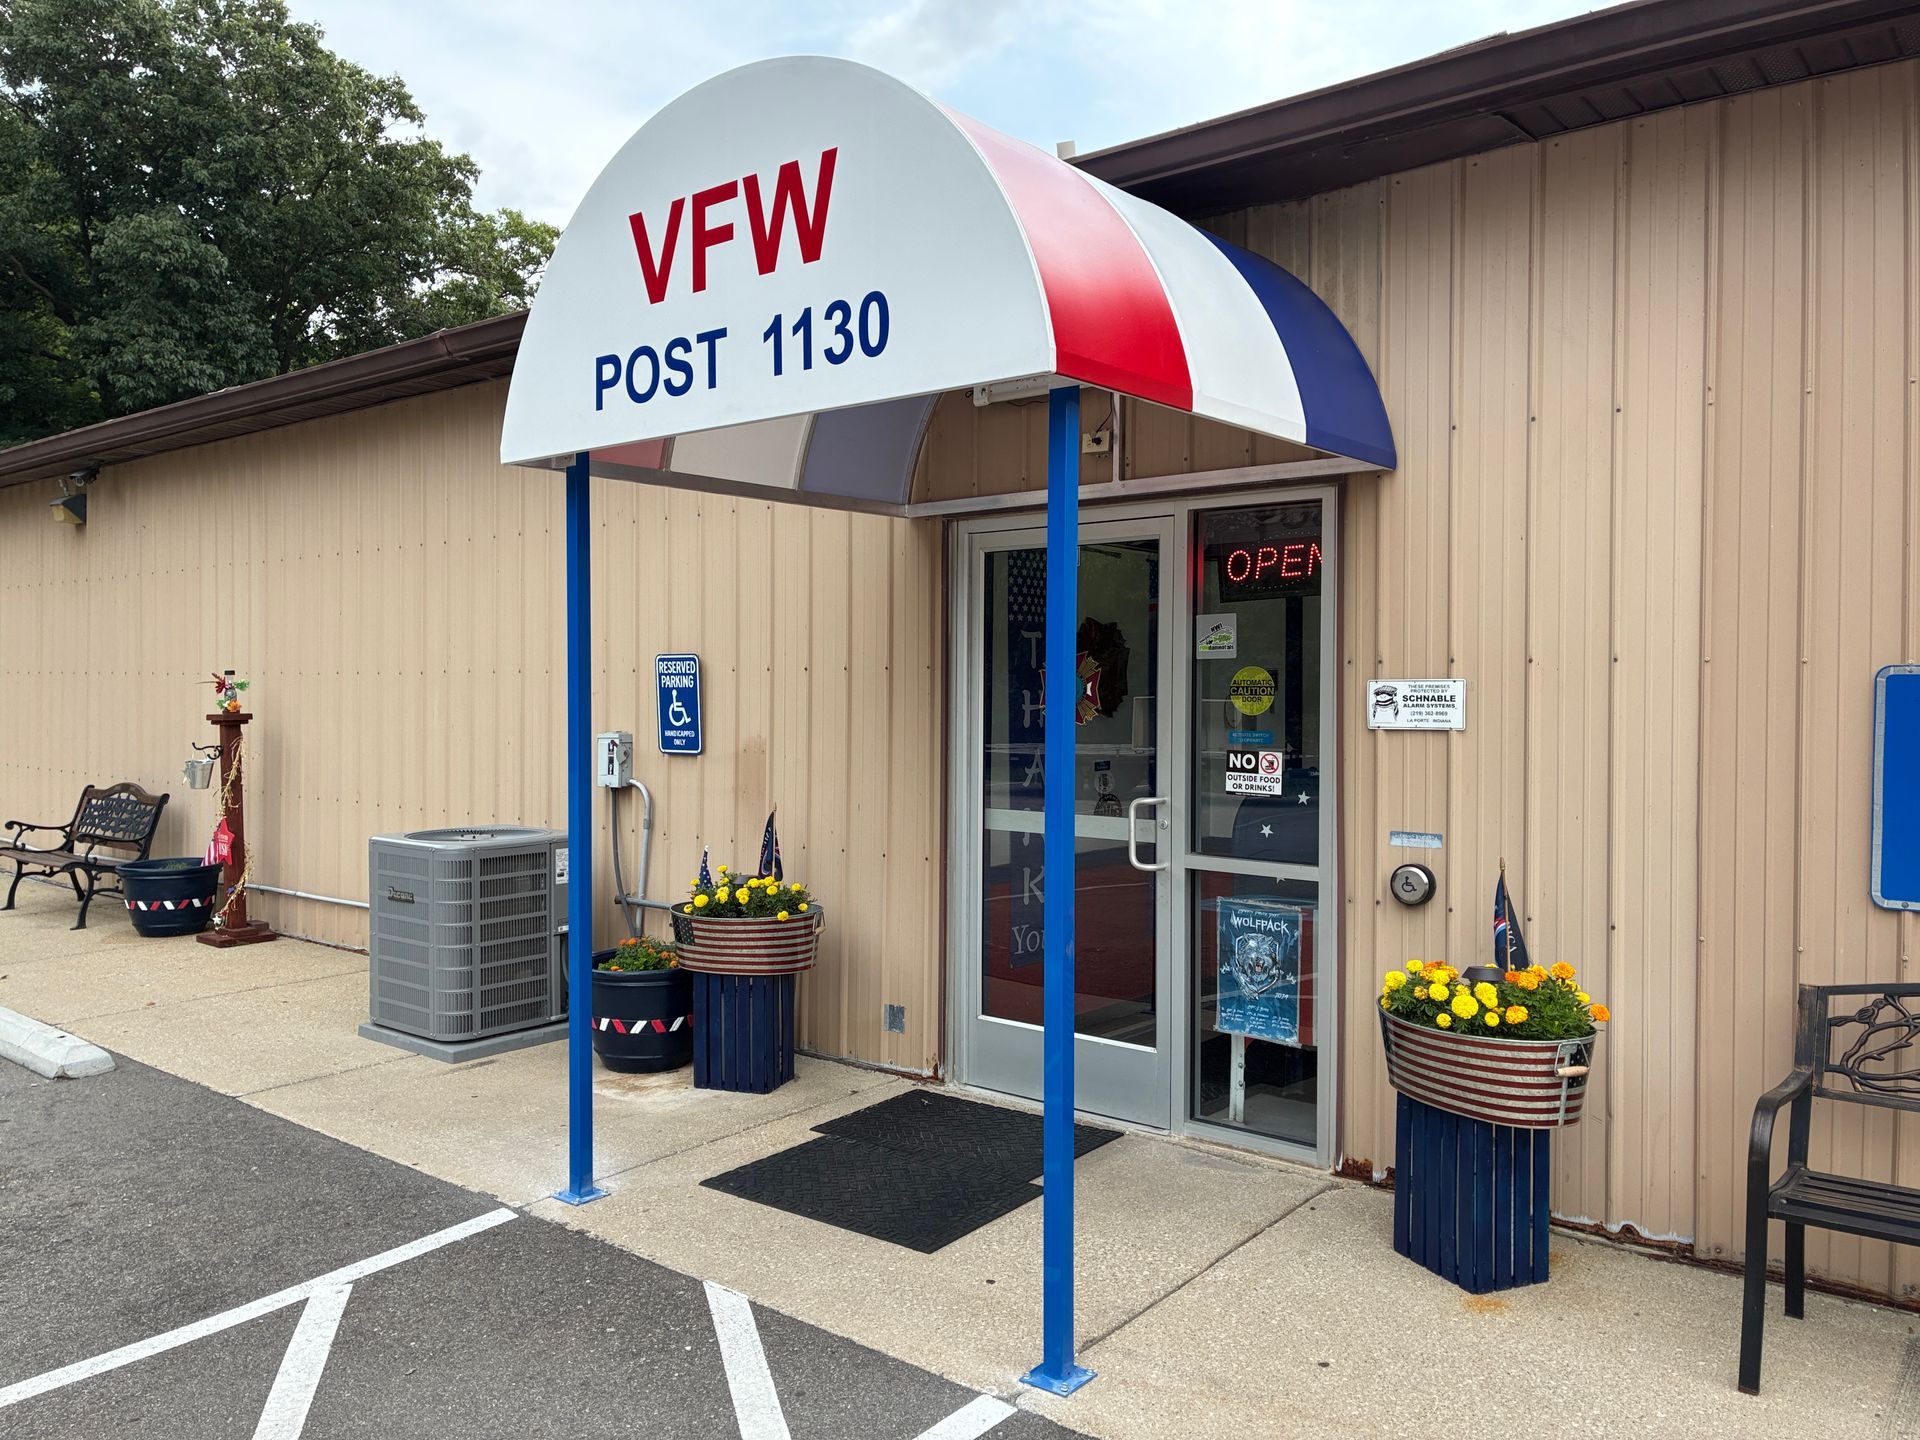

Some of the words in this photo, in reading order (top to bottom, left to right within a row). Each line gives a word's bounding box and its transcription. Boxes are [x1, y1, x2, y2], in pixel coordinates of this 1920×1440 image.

[629, 147, 838, 304] VFW
[595, 327, 727, 411] POST
[763, 290, 890, 376] 1130
[1227, 543, 1322, 581] OPEN
[658, 660, 696, 674] RESERVED
[661, 675, 694, 688] PARKING
[1230, 686, 1275, 696] CAUTION
[1402, 695, 1457, 703] SCHNABLE
[664, 730, 695, 738] HANDICAPPED
[1229, 753, 1256, 769] NO
[1227, 774, 1258, 783] OUTSIDE
[1259, 776, 1281, 784] FOOD
[1232, 782, 1243, 790] OR
[1244, 783, 1275, 793] DRINKS!
[1231, 911, 1290, 936] WOLFPACK
